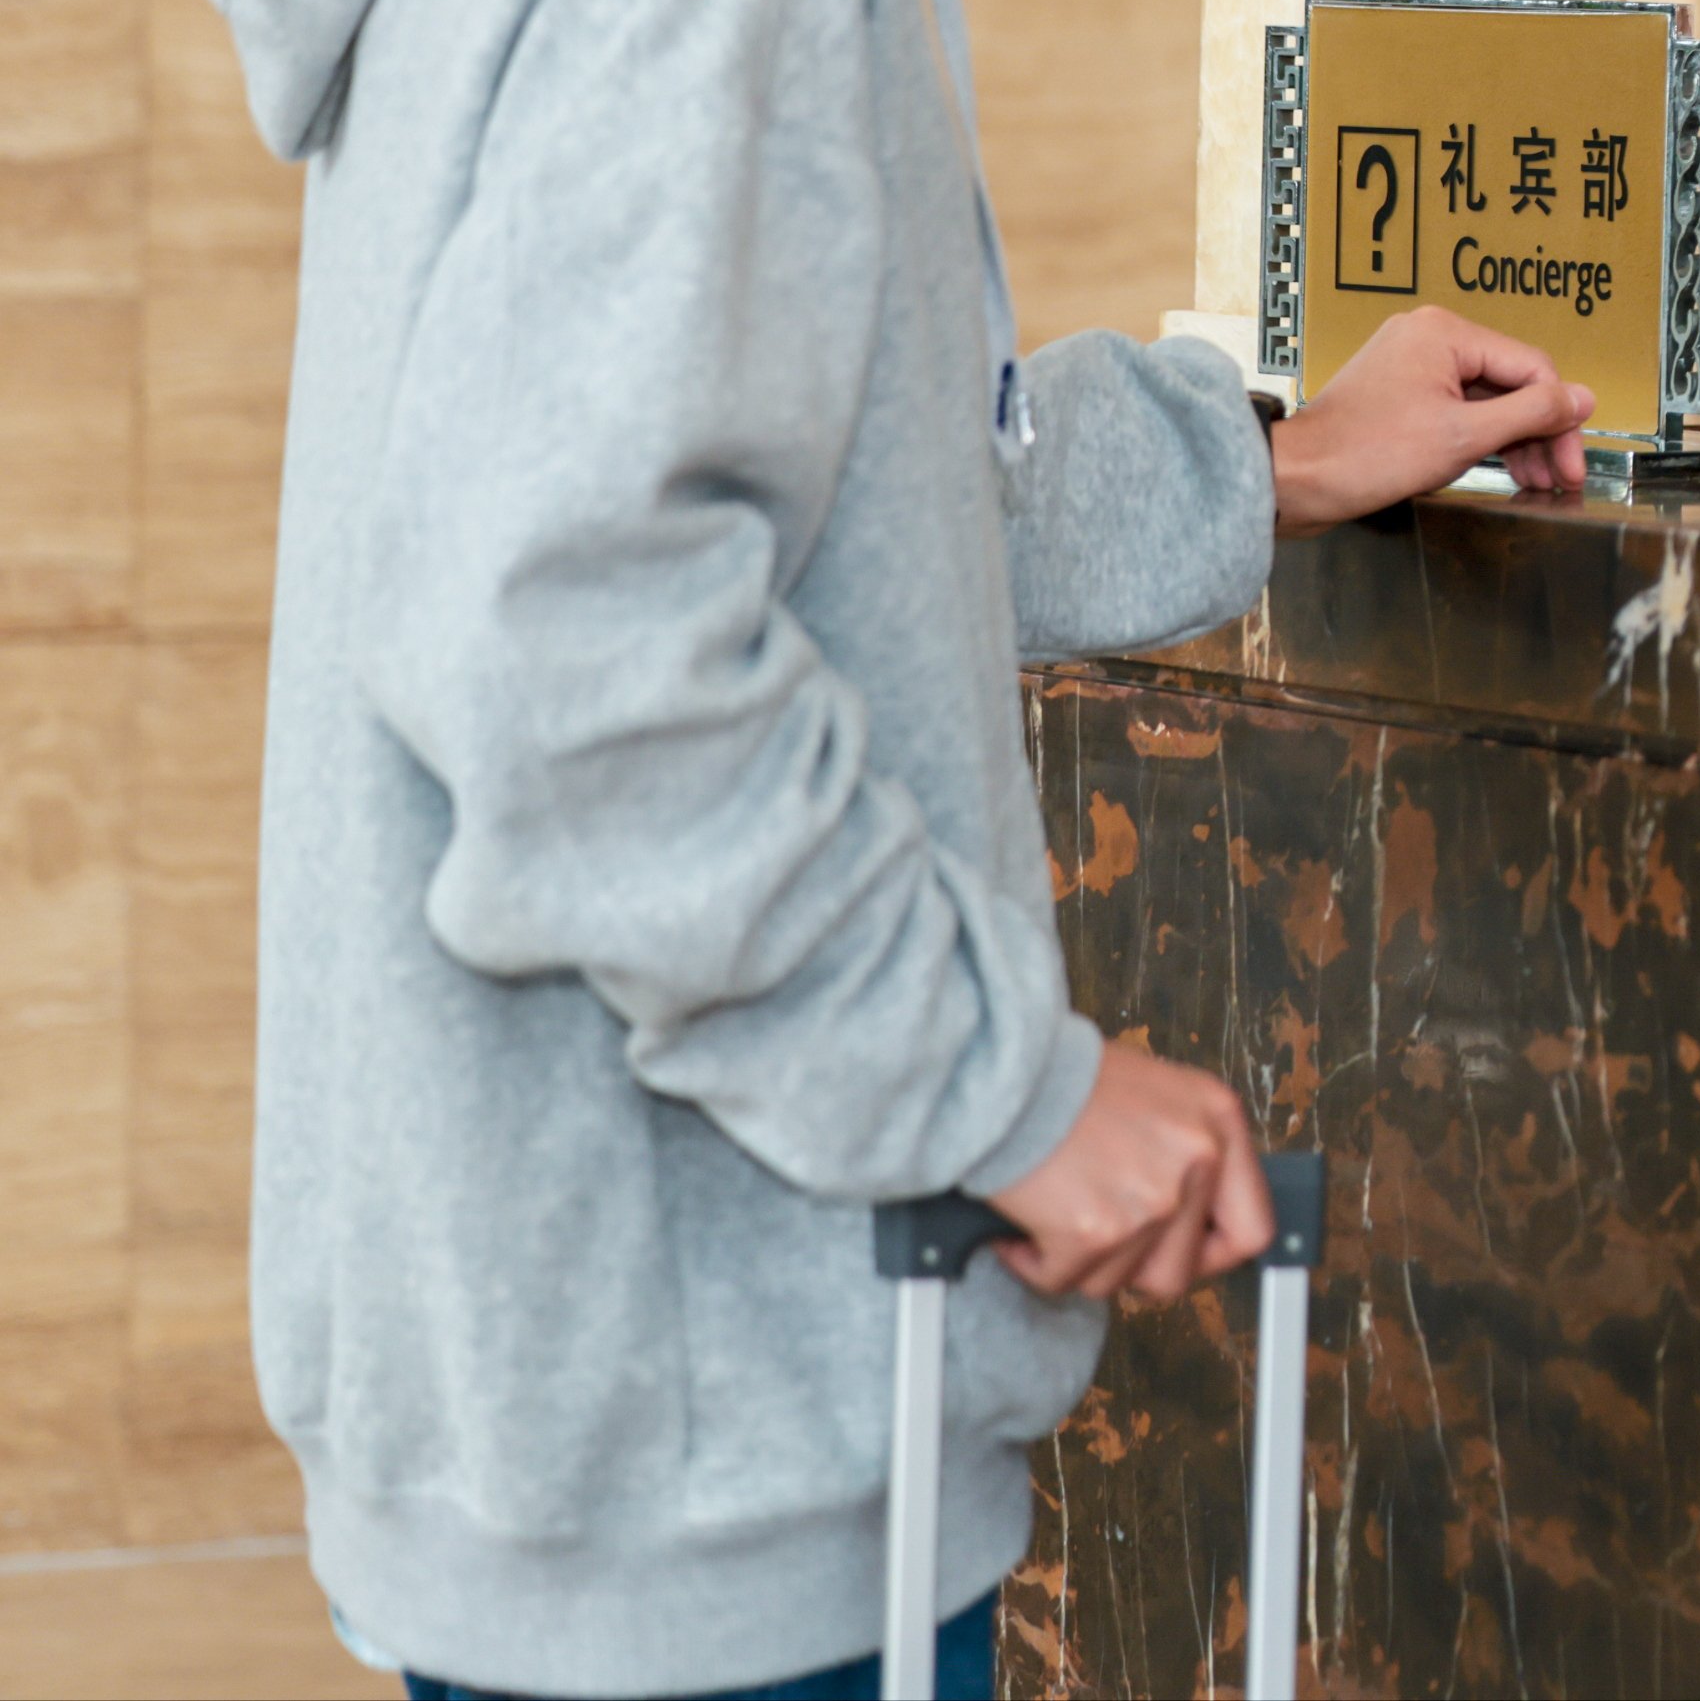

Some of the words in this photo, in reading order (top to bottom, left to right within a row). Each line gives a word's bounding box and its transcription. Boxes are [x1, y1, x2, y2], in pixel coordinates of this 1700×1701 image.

[1440, 123, 1629, 222] 礼宾部
[1452, 237, 1613, 317] Concierge
